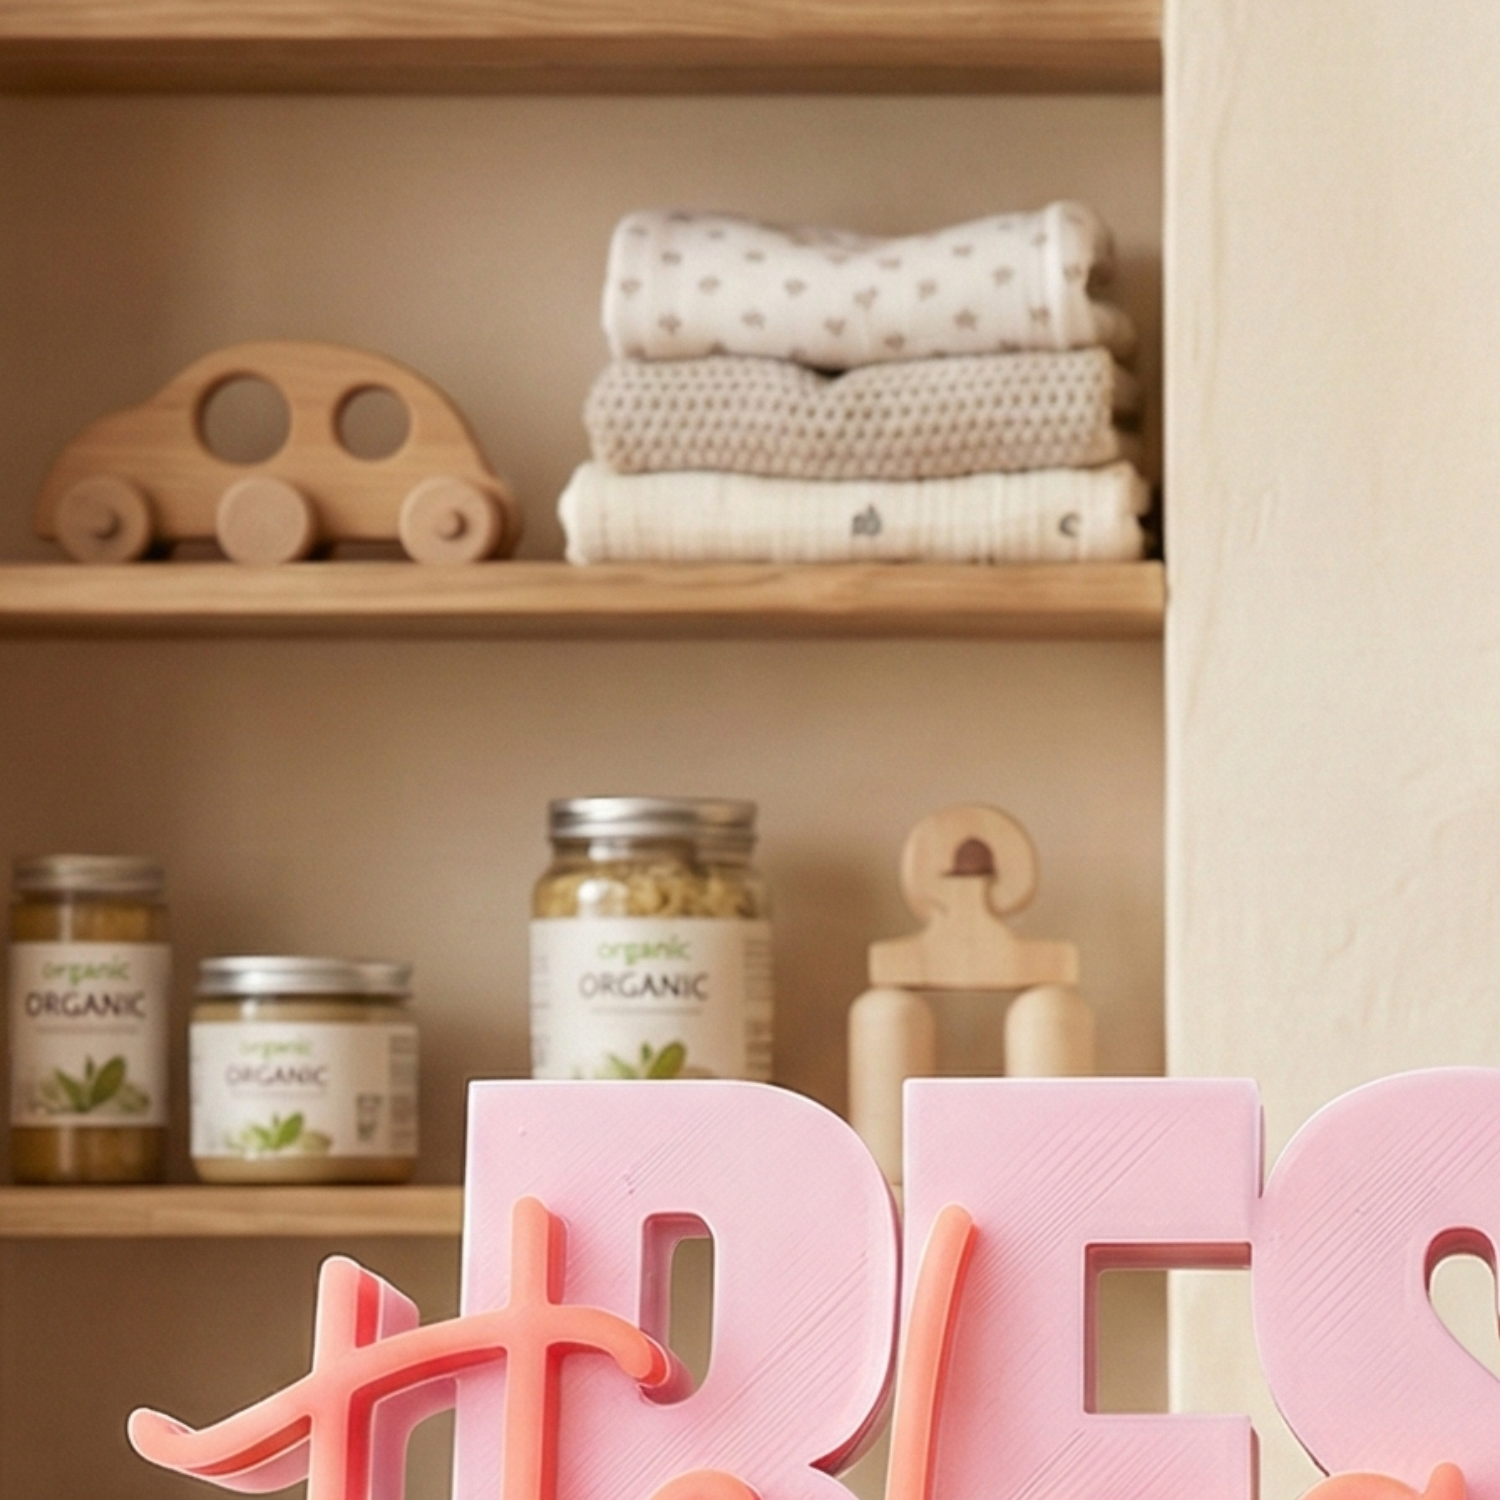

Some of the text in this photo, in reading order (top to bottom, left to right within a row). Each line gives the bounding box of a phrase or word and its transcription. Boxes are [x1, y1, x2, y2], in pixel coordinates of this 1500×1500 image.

[41, 955, 130, 985] organic
[578, 972, 708, 1000] ORGANIC
[25, 992, 146, 1018] ORGANIC
[226, 1063, 328, 1086] ORGANIC
